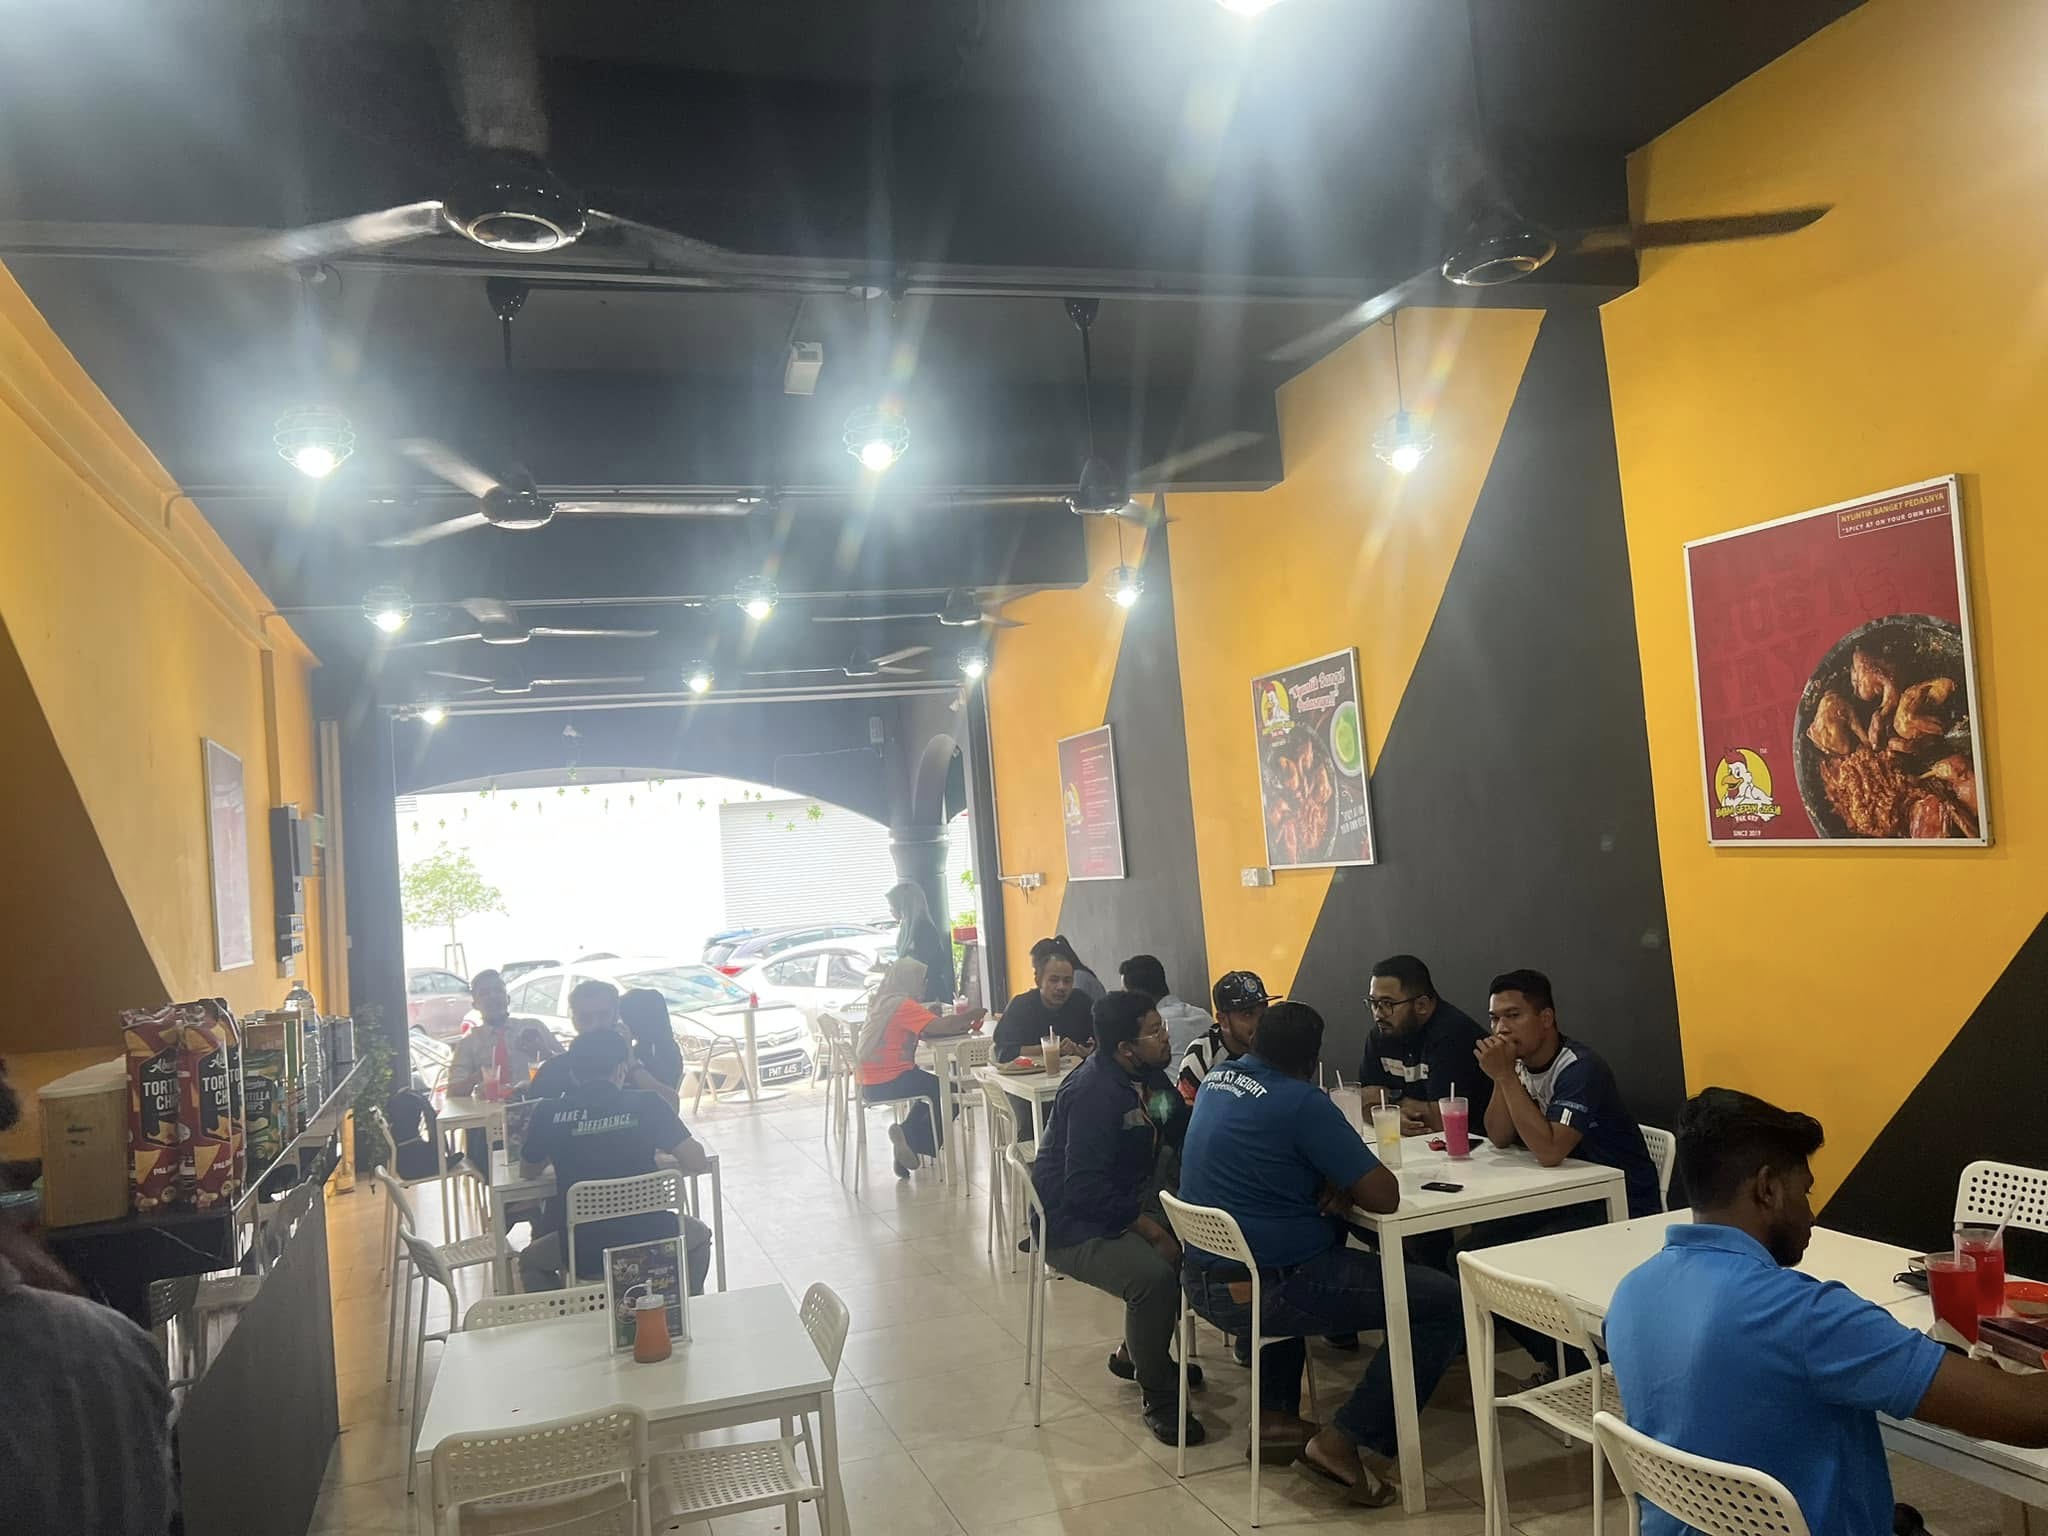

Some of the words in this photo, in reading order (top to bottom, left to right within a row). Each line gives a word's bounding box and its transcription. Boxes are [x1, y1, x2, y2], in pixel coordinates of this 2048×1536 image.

[1872, 501, 1903, 515] BANGET
[1904, 493, 1944, 507] PEDASNYA
[1887, 513, 1906, 523] YOUR
[1907, 509, 1924, 519] OWN
[1223, 1070, 1236, 1083] AT
[1235, 1072, 1268, 1098] HEIGHT
[553, 1109, 579, 1124] MAKE
[580, 1108, 588, 1121] A
[577, 1112, 632, 1132] DIFFERENCE
